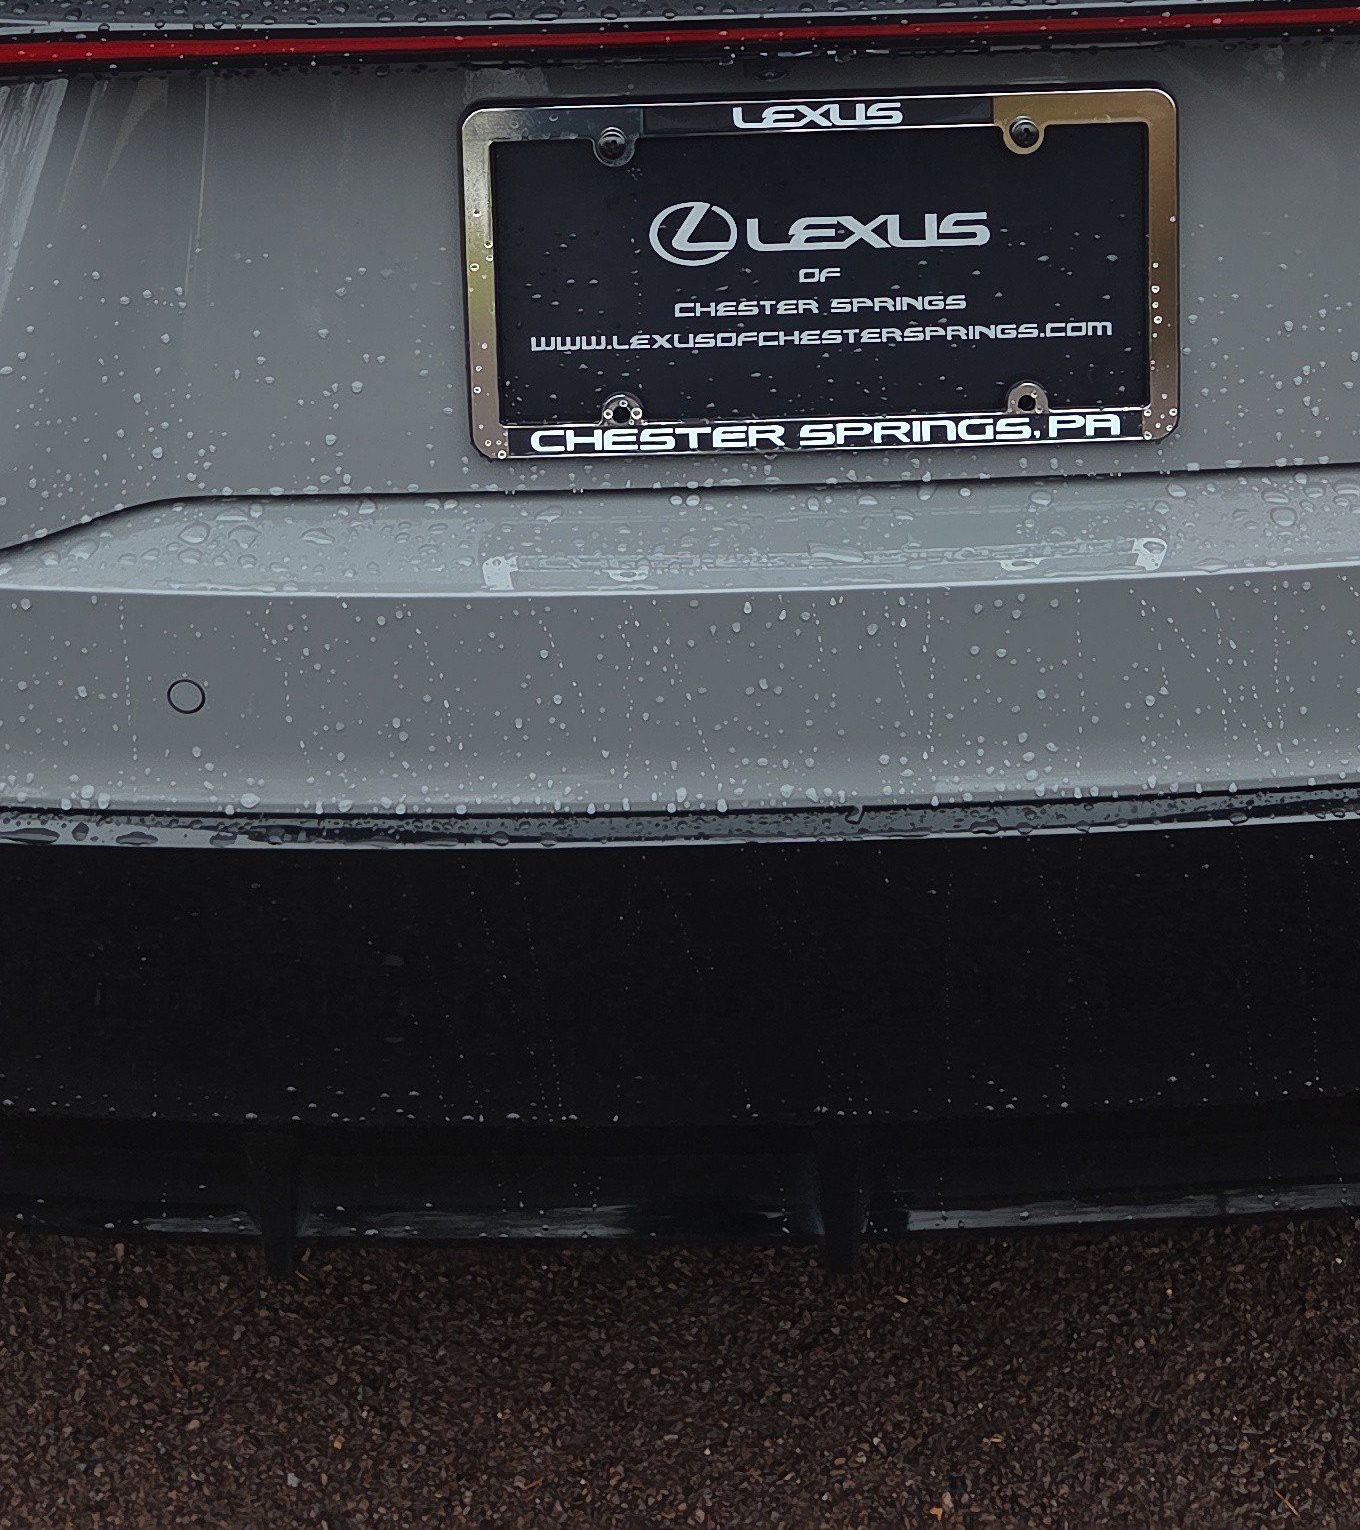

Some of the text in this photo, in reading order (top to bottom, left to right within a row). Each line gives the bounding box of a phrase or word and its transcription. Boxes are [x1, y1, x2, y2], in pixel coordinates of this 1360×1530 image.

[732, 101, 904, 129] LEXUS
[746, 211, 991, 252] LEXUS
[799, 267, 841, 283] OF
[674, 294, 967, 318] CHESTER SPRINGS
[530, 413, 1121, 452] CHESTER SPRINGS, PA
